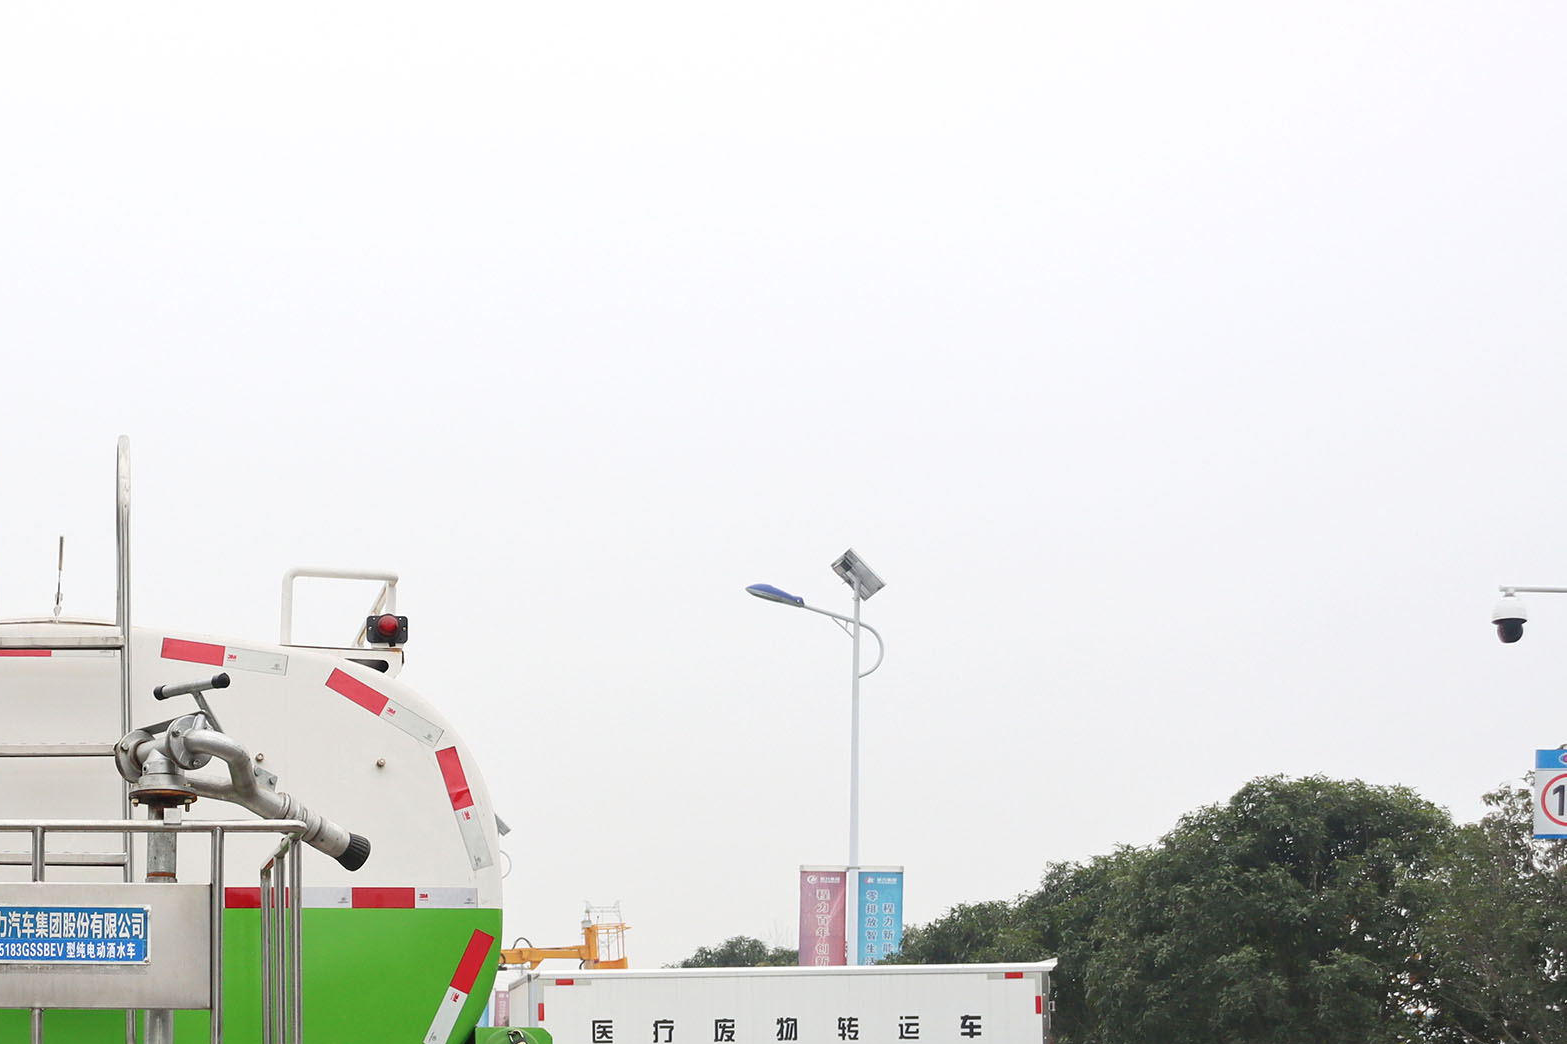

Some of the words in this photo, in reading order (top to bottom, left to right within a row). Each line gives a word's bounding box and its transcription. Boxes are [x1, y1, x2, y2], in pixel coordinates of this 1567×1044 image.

[66, 942, 136, 959] 型纯电动洒水车
[591, 1014, 983, 1044] 医疗废物转运车
